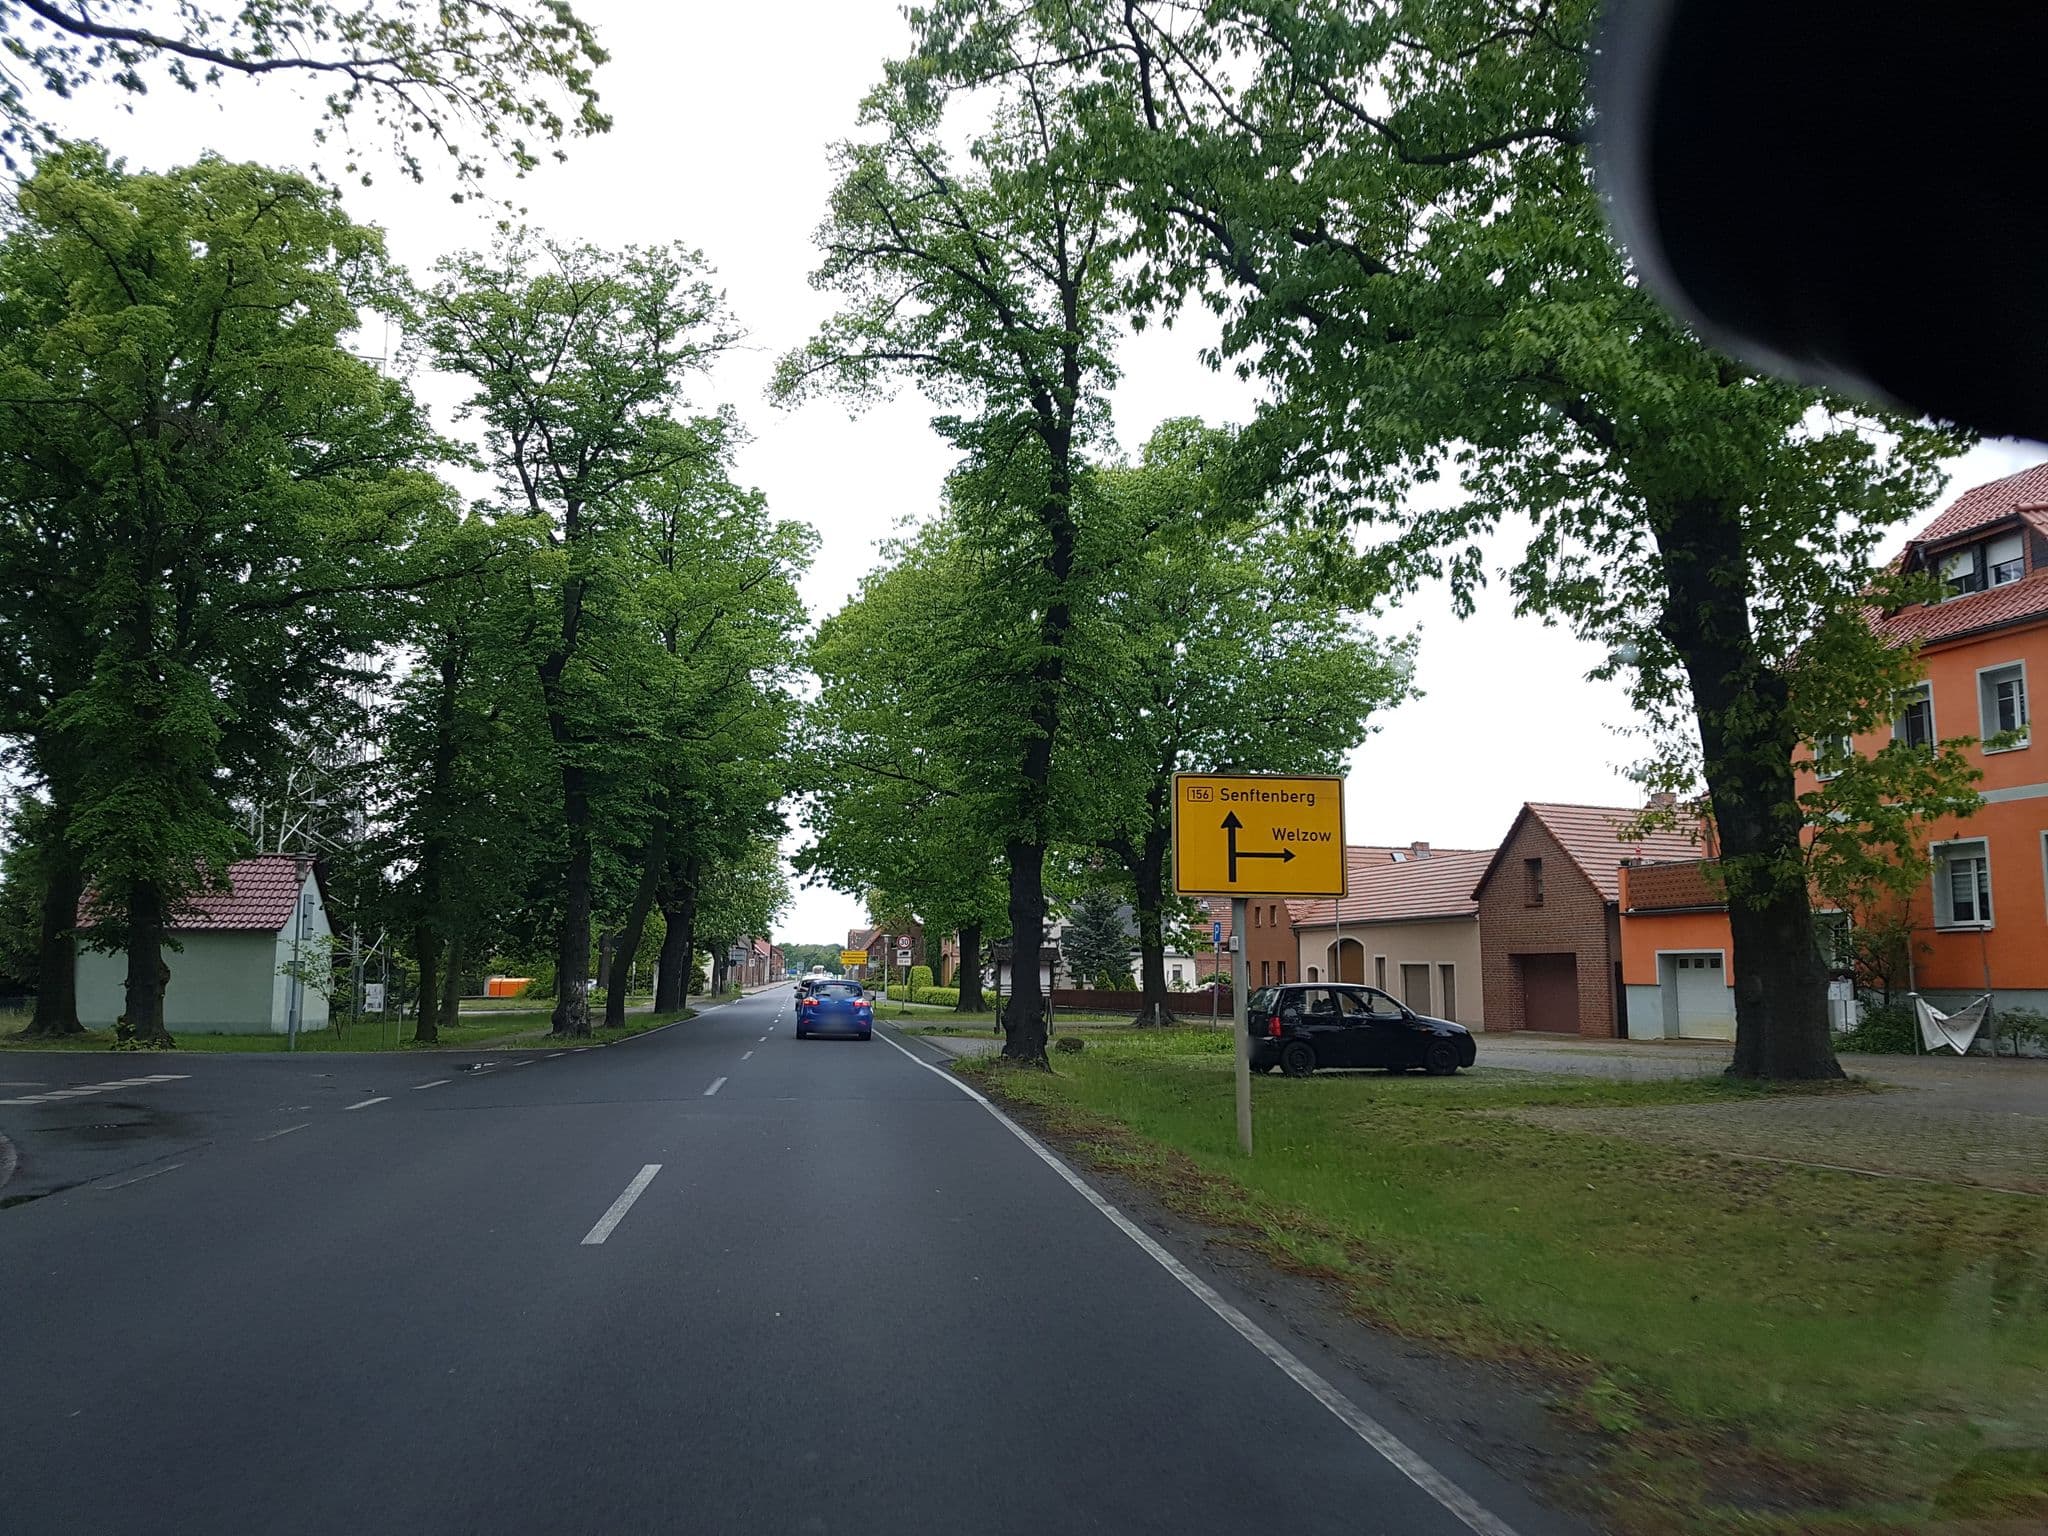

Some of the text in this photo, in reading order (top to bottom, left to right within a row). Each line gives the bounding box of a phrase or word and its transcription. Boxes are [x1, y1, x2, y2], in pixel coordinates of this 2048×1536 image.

[1191, 788, 1315, 806] 156 Senftenberg
[1272, 828, 1332, 842] Welzow
